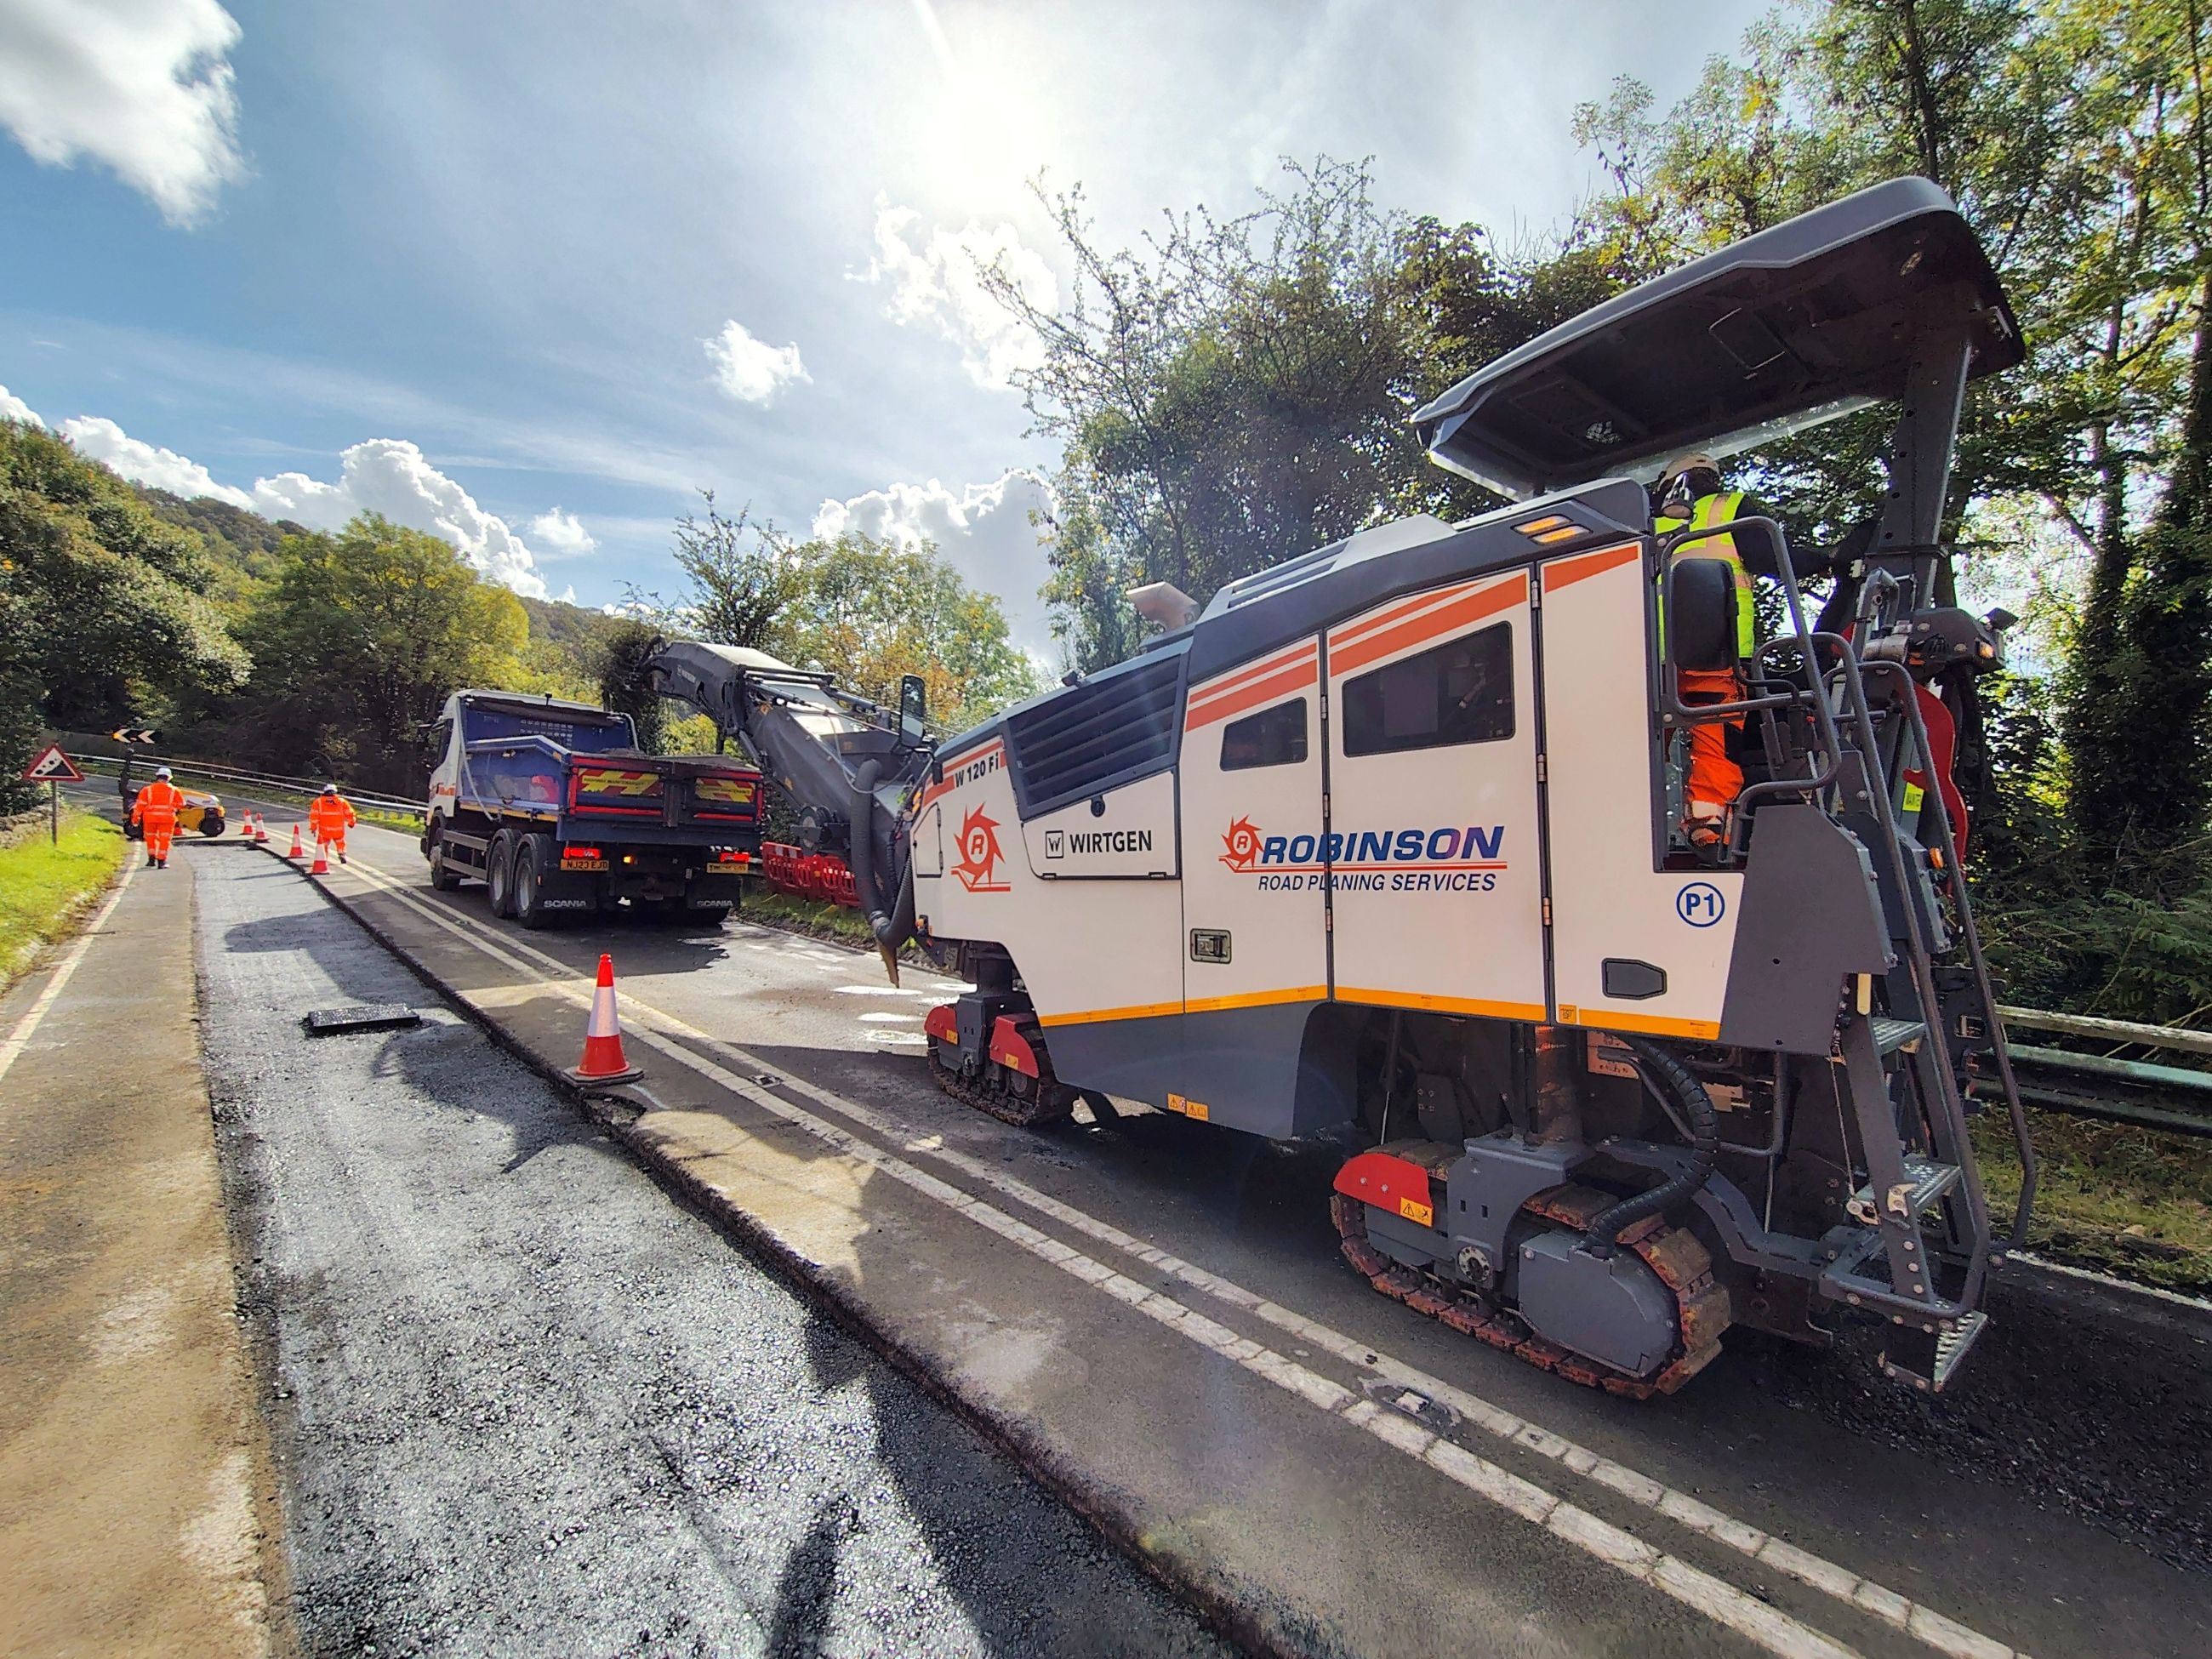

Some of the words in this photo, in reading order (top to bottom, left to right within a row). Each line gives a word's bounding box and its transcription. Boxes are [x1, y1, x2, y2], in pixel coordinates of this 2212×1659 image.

[955, 769, 964, 788] W
[966, 760, 986, 782] 120
[989, 751, 999, 773] Fi
[970, 834, 984, 855] R
[1069, 830, 1152, 853] WIRTGEN
[1236, 835, 1249, 849] R
[1261, 825, 1505, 864] ROBINSON
[1258, 875, 1303, 891] ROAD
[1308, 874, 1385, 892] PLANING
[1391, 873, 1497, 892] SERVICES
[544, 899, 587, 908] SCANIA
[696, 899, 733, 908] SCANIA
[1685, 892, 1714, 917] P1
